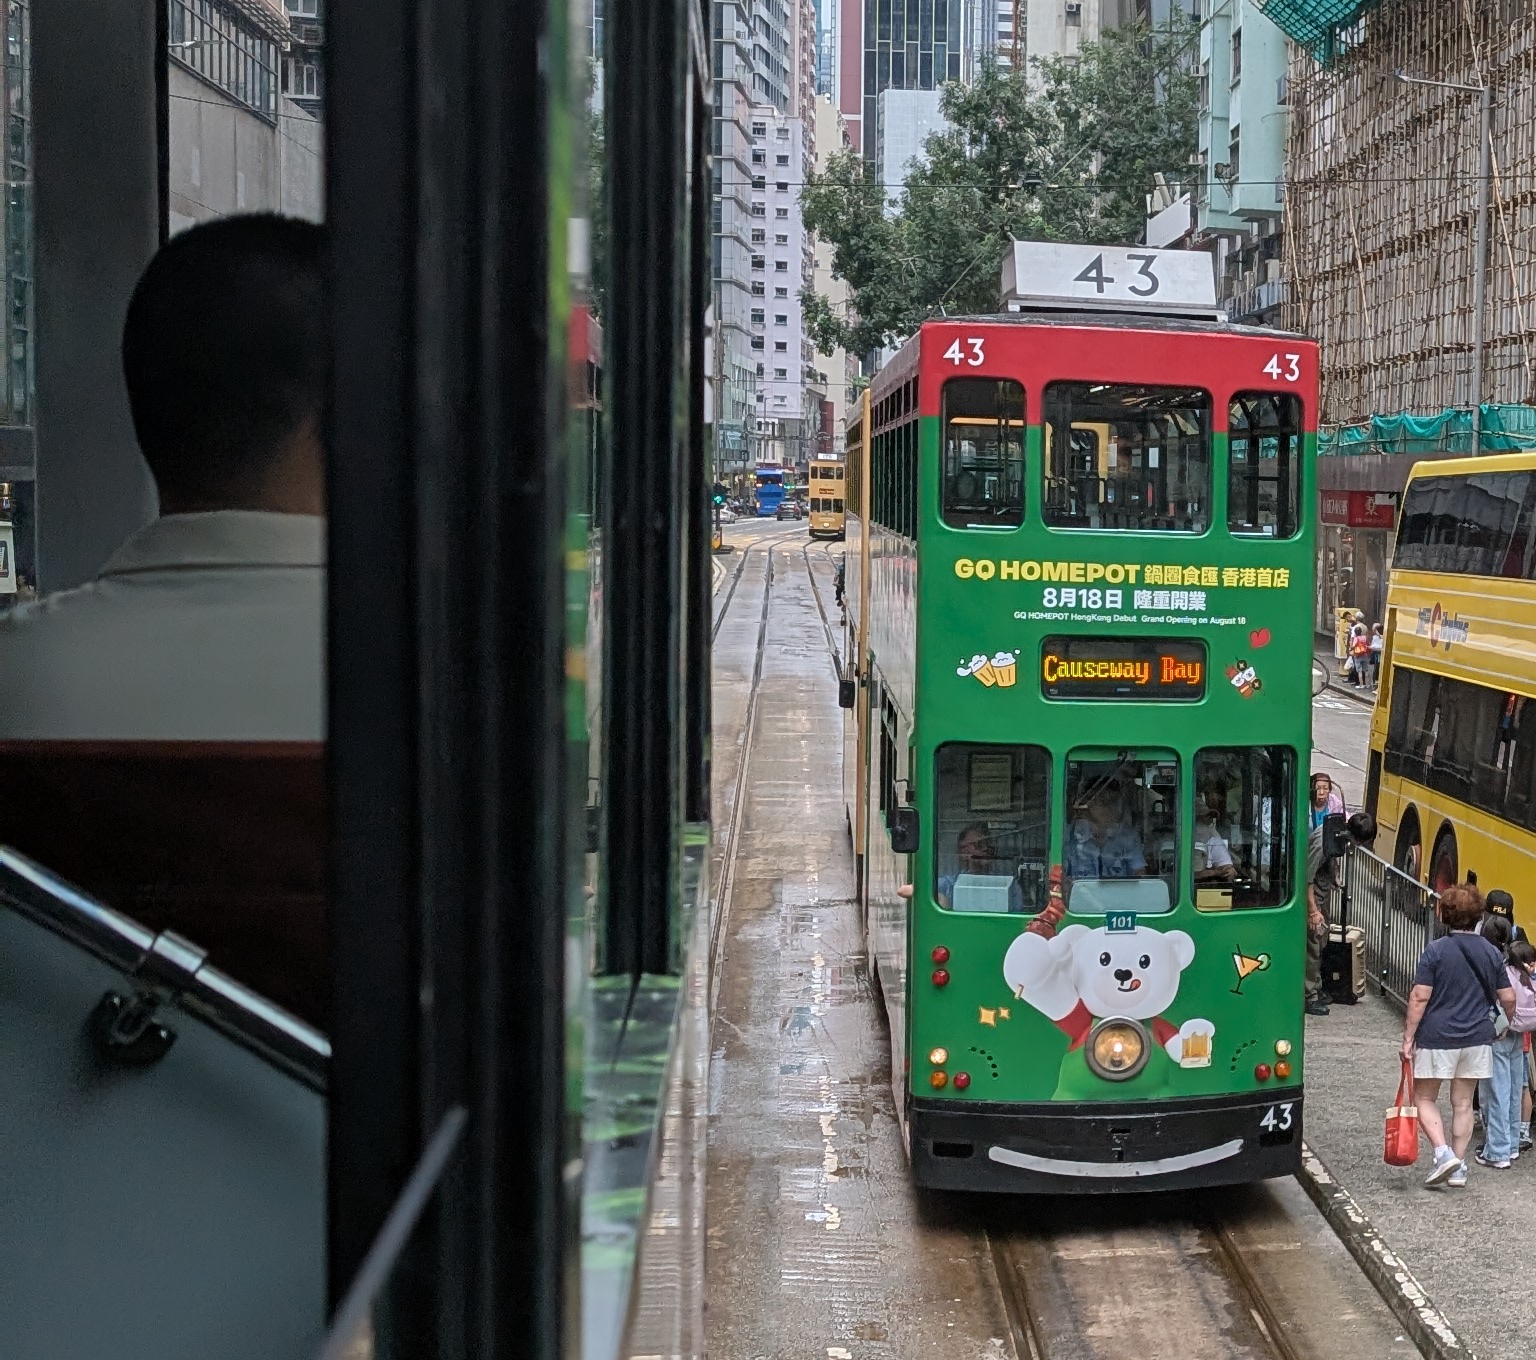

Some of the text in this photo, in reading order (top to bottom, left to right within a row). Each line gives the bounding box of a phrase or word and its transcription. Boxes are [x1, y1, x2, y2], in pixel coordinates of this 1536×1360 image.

[1073, 252, 1160, 298] 43
[942, 337, 986, 367] 43
[1262, 353, 1301, 382] 43
[954, 558, 1141, 585] GQ HOMEPOT
[1143, 564, 1291, 588] 鍋圈食匯 香港首店
[1042, 587, 1207, 612] 8月18日 隆重開業
[1028, 611, 1070, 621] HOMEPOT
[1113, 613, 1137, 623] Debut
[1141, 614, 1165, 623] Grand
[1166, 615, 1197, 626] Opening
[1210, 616, 1236, 626] August
[1043, 655, 1201, 685] Causeway Bay
[1110, 915, 1133, 929] 101
[1492, 905, 1507, 915] FILA
[1259, 1102, 1293, 1132] 43
